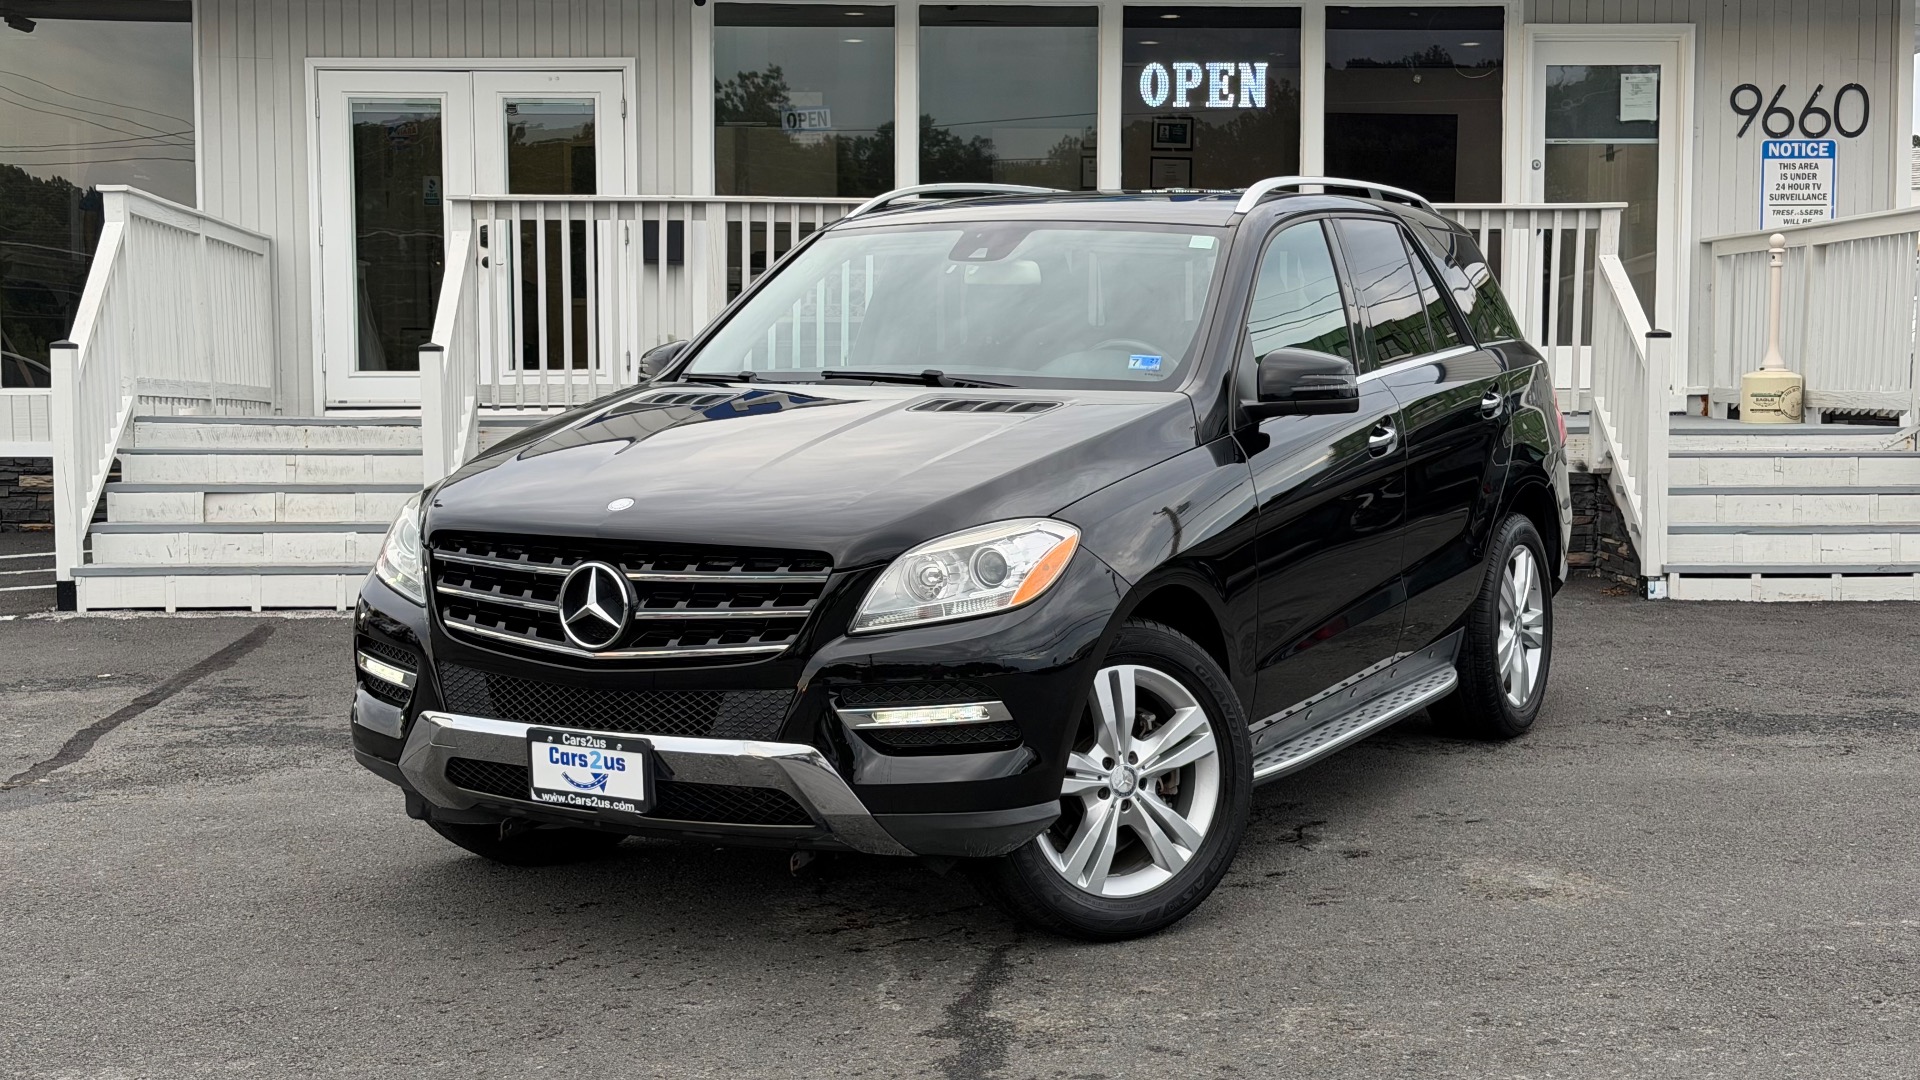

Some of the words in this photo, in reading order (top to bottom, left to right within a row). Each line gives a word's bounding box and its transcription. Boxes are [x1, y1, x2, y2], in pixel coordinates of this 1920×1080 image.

[1139, 61, 1269, 108] OPEN
[1729, 83, 1870, 139] 9660
[786, 110, 828, 129] OPEN
[1768, 142, 1830, 157] NOTICE
[1778, 162, 1796, 171] THIS
[1798, 162, 1819, 171] AREA
[1780, 172, 1788, 181] IS
[1790, 172, 1817, 181] UNDER
[1775, 182, 1786, 191] 24
[1788, 182, 1810, 191] HOUR
[1812, 182, 1822, 191] TV
[1769, 193, 1828, 201] SURVEILLANCE
[1132, 358, 1140, 367] 7
[562, 733, 607, 749] Cars2us
[548, 746, 626, 772] Cars2us
[541, 792, 635, 812] www.Cars2us.com
